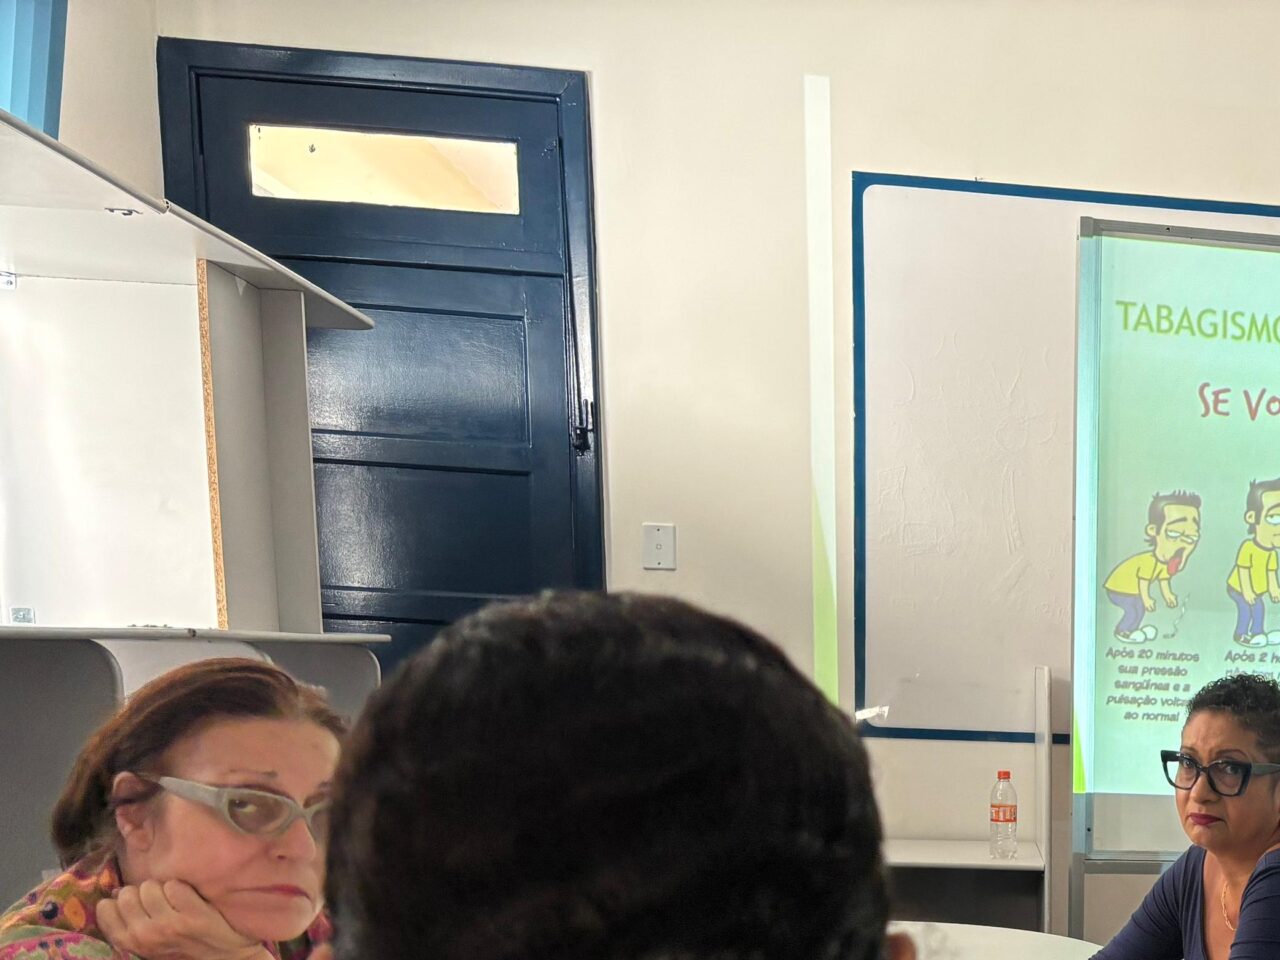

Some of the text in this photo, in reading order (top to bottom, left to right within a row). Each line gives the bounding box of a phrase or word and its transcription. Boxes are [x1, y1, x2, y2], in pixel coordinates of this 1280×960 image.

[1198, 382, 1232, 418] SE
[1105, 647, 1200, 662] Após 20 minutos
[1225, 650, 1255, 664] Após
[1259, 652, 1267, 662] 2
[1118, 665, 1188, 676] sua pressão
[1173, 683, 1180, 691] e
[1183, 684, 1190, 692] a
[1106, 694, 1157, 707] pulsação
[1124, 711, 1180, 721] ao normal
